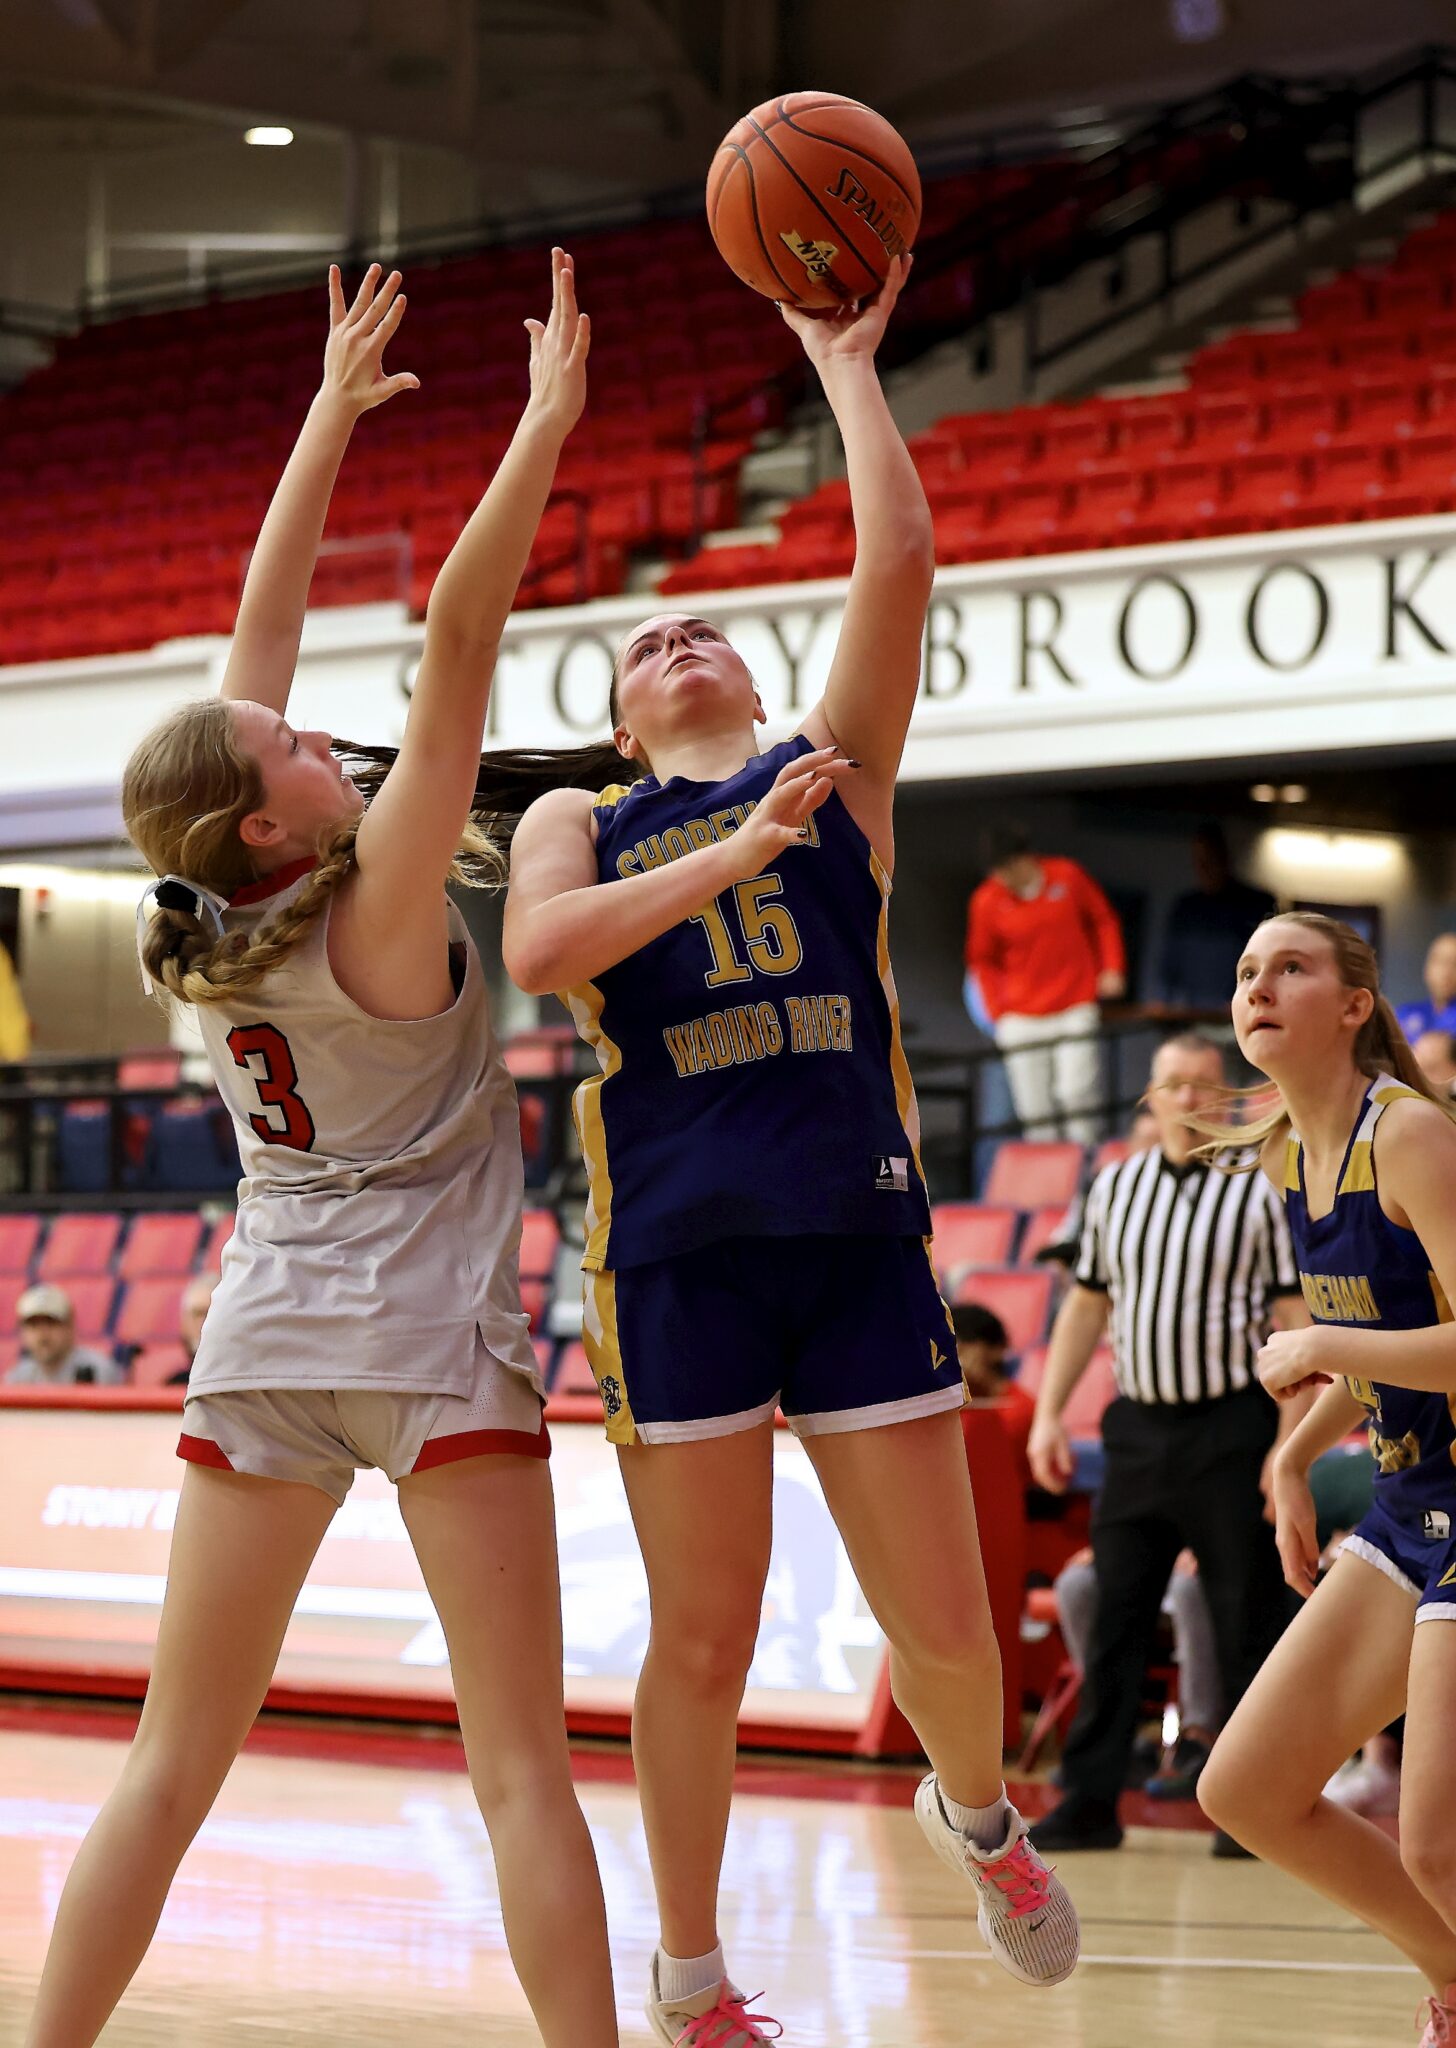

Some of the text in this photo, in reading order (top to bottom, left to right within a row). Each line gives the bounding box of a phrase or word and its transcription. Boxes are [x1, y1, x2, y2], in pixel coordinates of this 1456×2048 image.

[922, 549, 1448, 699] BROOK
[616, 801, 820, 879] SHORE
[690, 874, 802, 988] 15
[226, 1022, 315, 1153] 3
[664, 995, 853, 1077] WADING RIVER
